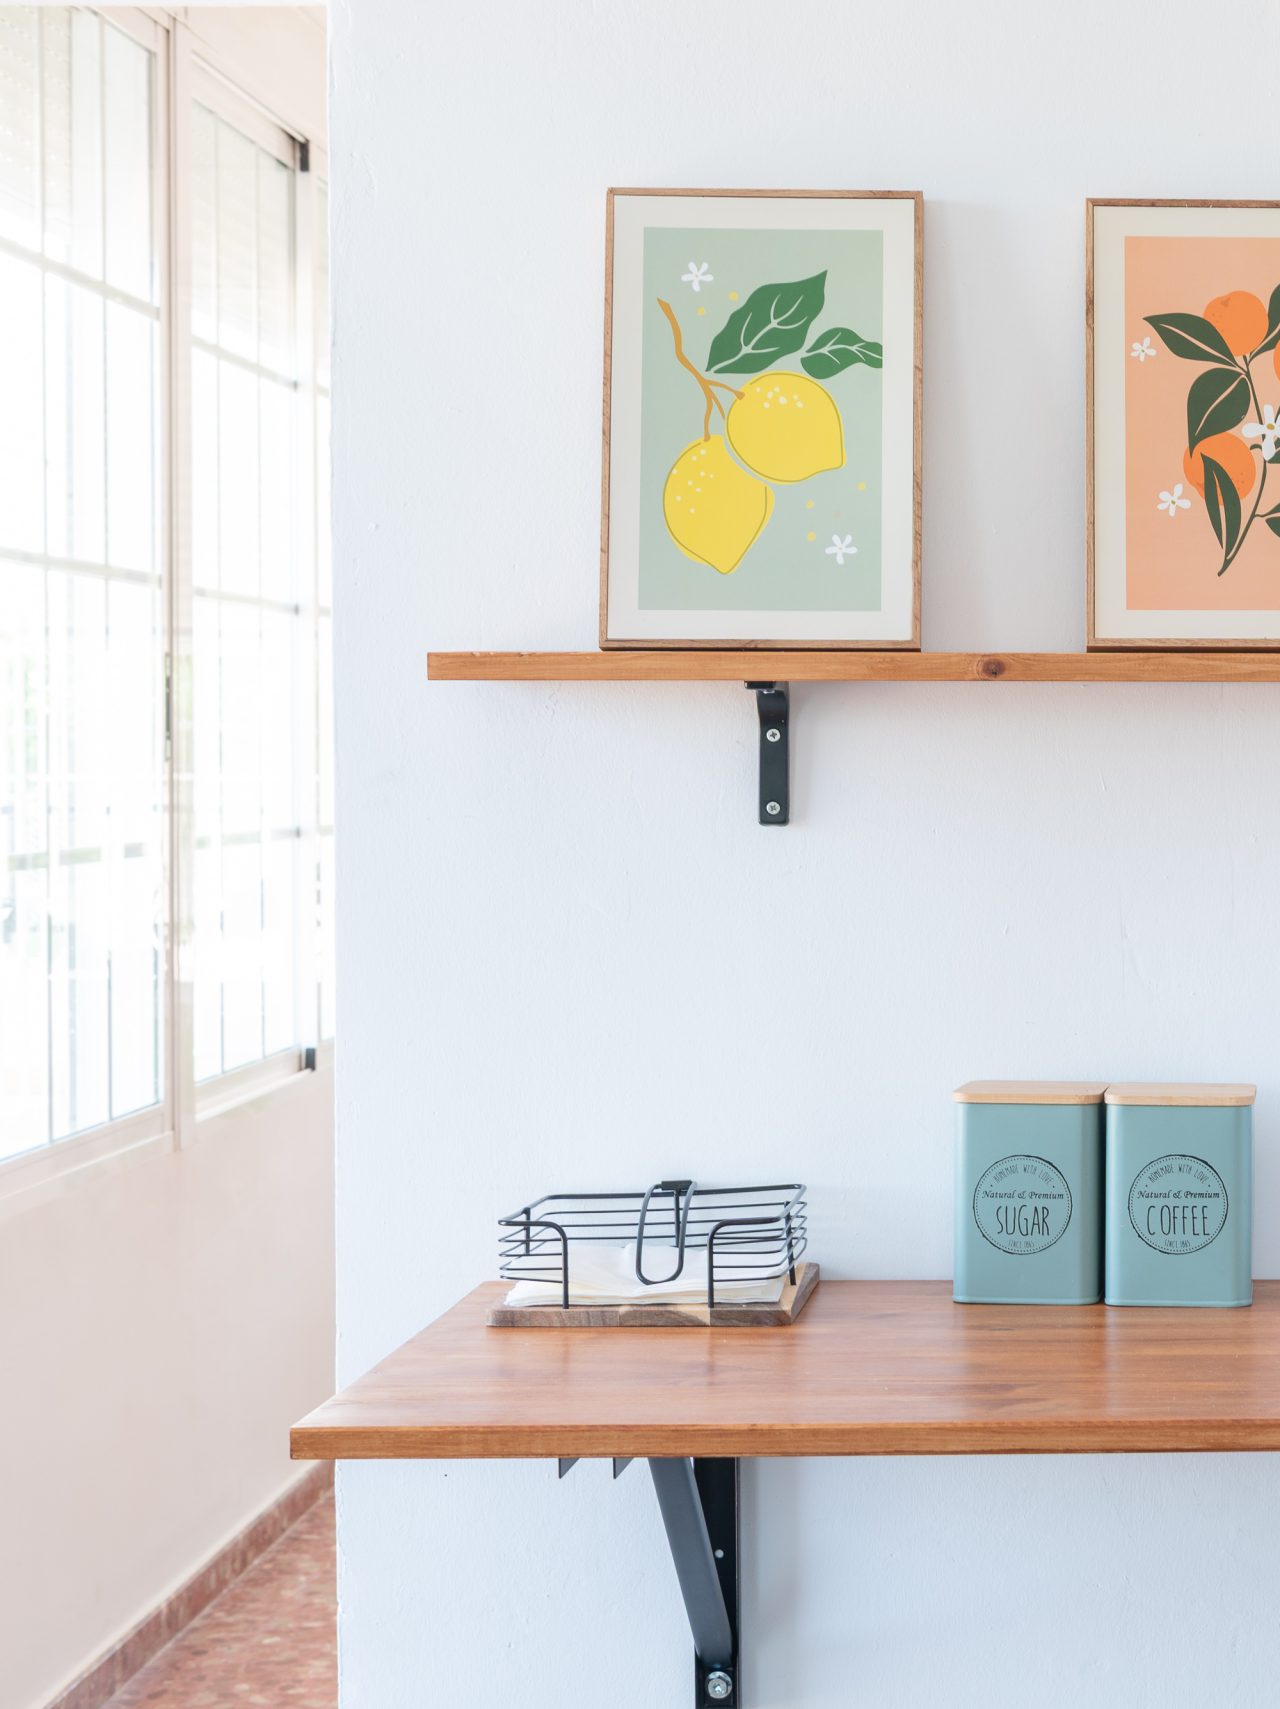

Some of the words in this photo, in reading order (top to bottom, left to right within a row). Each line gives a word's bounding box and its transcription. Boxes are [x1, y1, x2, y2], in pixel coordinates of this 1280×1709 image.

[993, 1164, 1019, 1184] HOMEMADE
[1023, 1164, 1038, 1175] WITH
[1038, 1169, 1054, 1185] LOVE
[1148, 1163, 1174, 1184] HOMEMADE
[1178, 1163, 1192, 1174] WITH
[1193, 1169, 1209, 1184] LOVE
[982, 1189, 1017, 1199] Natural
[1017, 1190, 1027, 1199] &
[1028, 1190, 1064, 1199] Premium
[1137, 1189, 1172, 1199] Natural
[1172, 1190, 1182, 1199] &
[1184, 1190, 1220, 1199] Premium
[996, 1204, 1050, 1237] SUGAR
[1147, 1204, 1210, 1236] COFFEE
